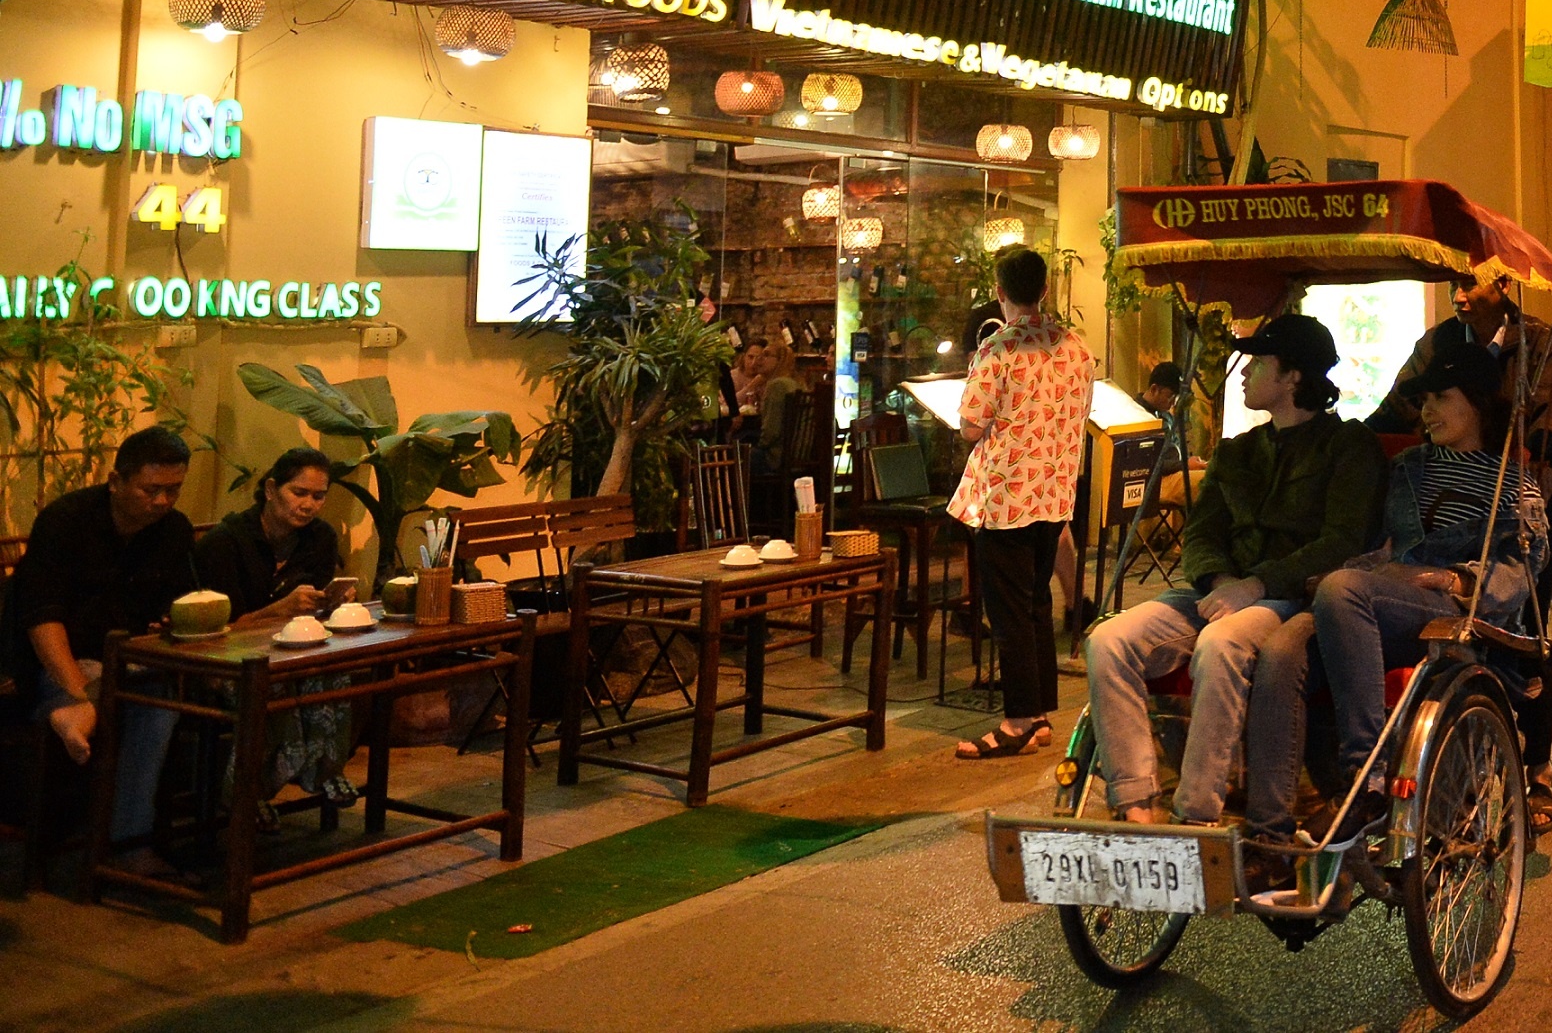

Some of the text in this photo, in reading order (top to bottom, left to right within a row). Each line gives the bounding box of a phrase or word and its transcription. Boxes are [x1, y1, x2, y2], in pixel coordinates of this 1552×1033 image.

[981, 41, 1132, 101] Vegetarian
[1138, 75, 1230, 115] Options
[53, 84, 124, 153] No
[133, 89, 243, 160] MSG
[134, 183, 227, 234] 44
[1199, 198, 1240, 223] HUY
[1322, 194, 1355, 218] JSC
[1362, 193, 1390, 218] 64
[275, 280, 382, 319] CLASS
[1127, 487, 1142, 499] VISA
